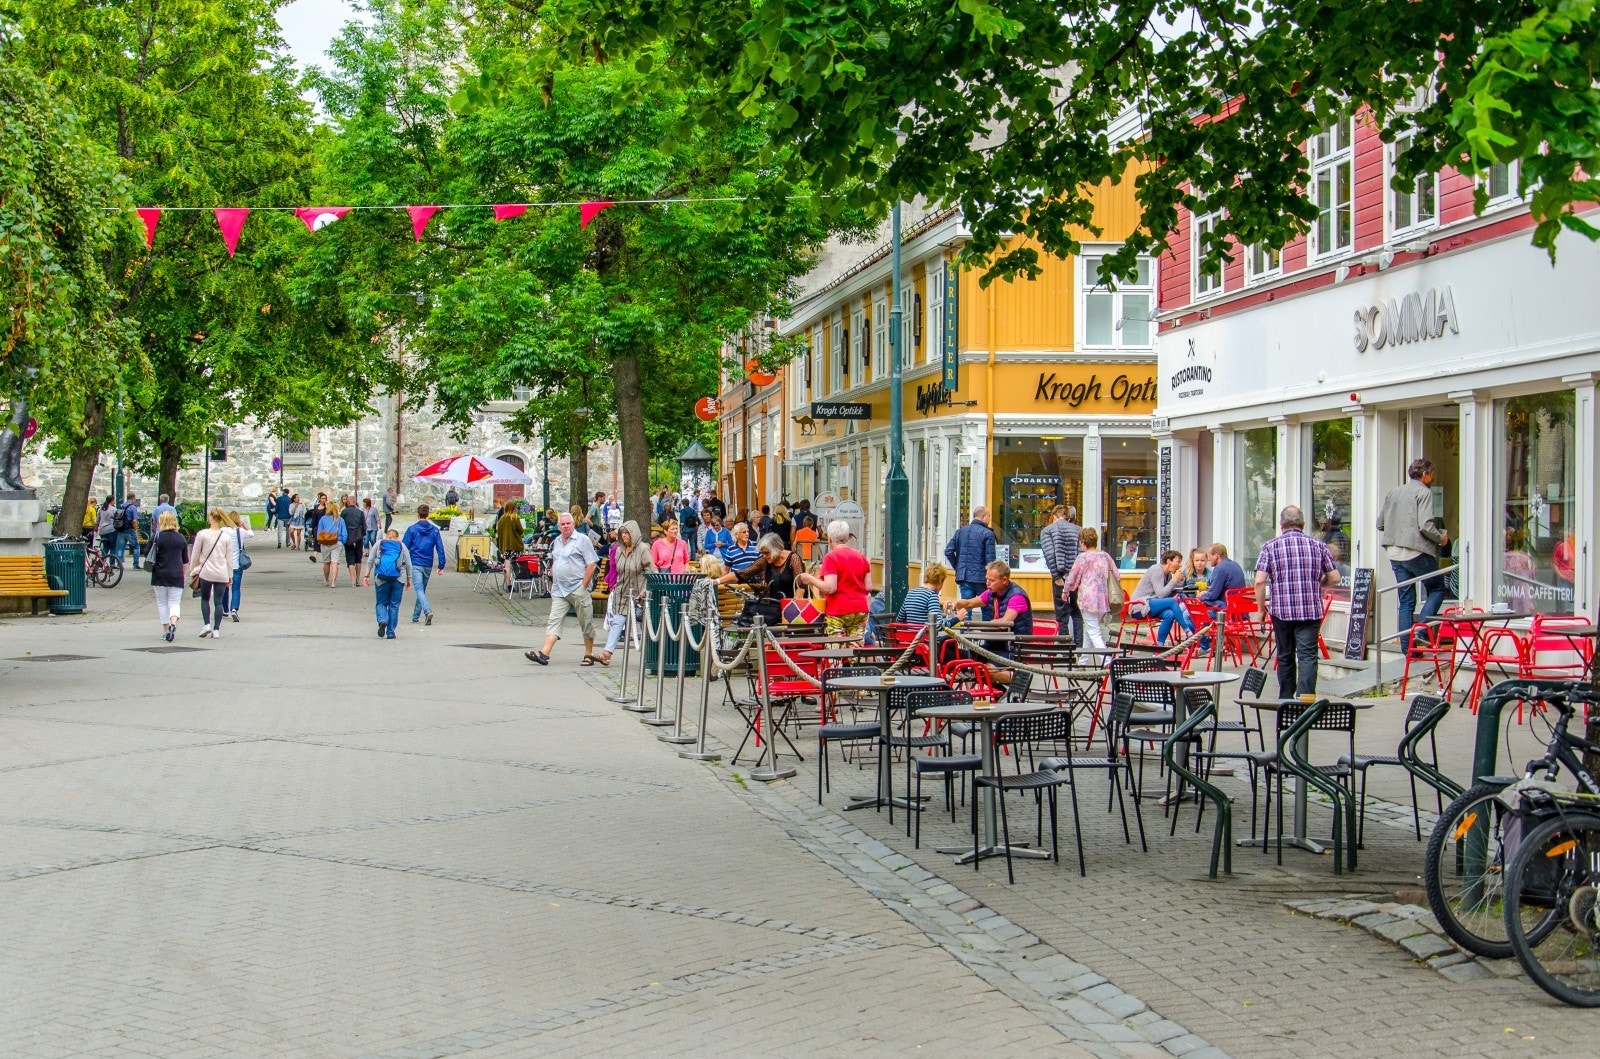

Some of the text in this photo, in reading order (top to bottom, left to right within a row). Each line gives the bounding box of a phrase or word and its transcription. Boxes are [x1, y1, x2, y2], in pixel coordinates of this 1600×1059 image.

[946, 269, 956, 380] BRILLER
[1353, 283, 1459, 353] SOMMA
[1034, 373, 1102, 408] Krogh
[1171, 365, 1212, 391] RISTORANTINO
[816, 404, 864, 417] Krogh Optikk
[1497, 584, 1526, 599] SOMMA
